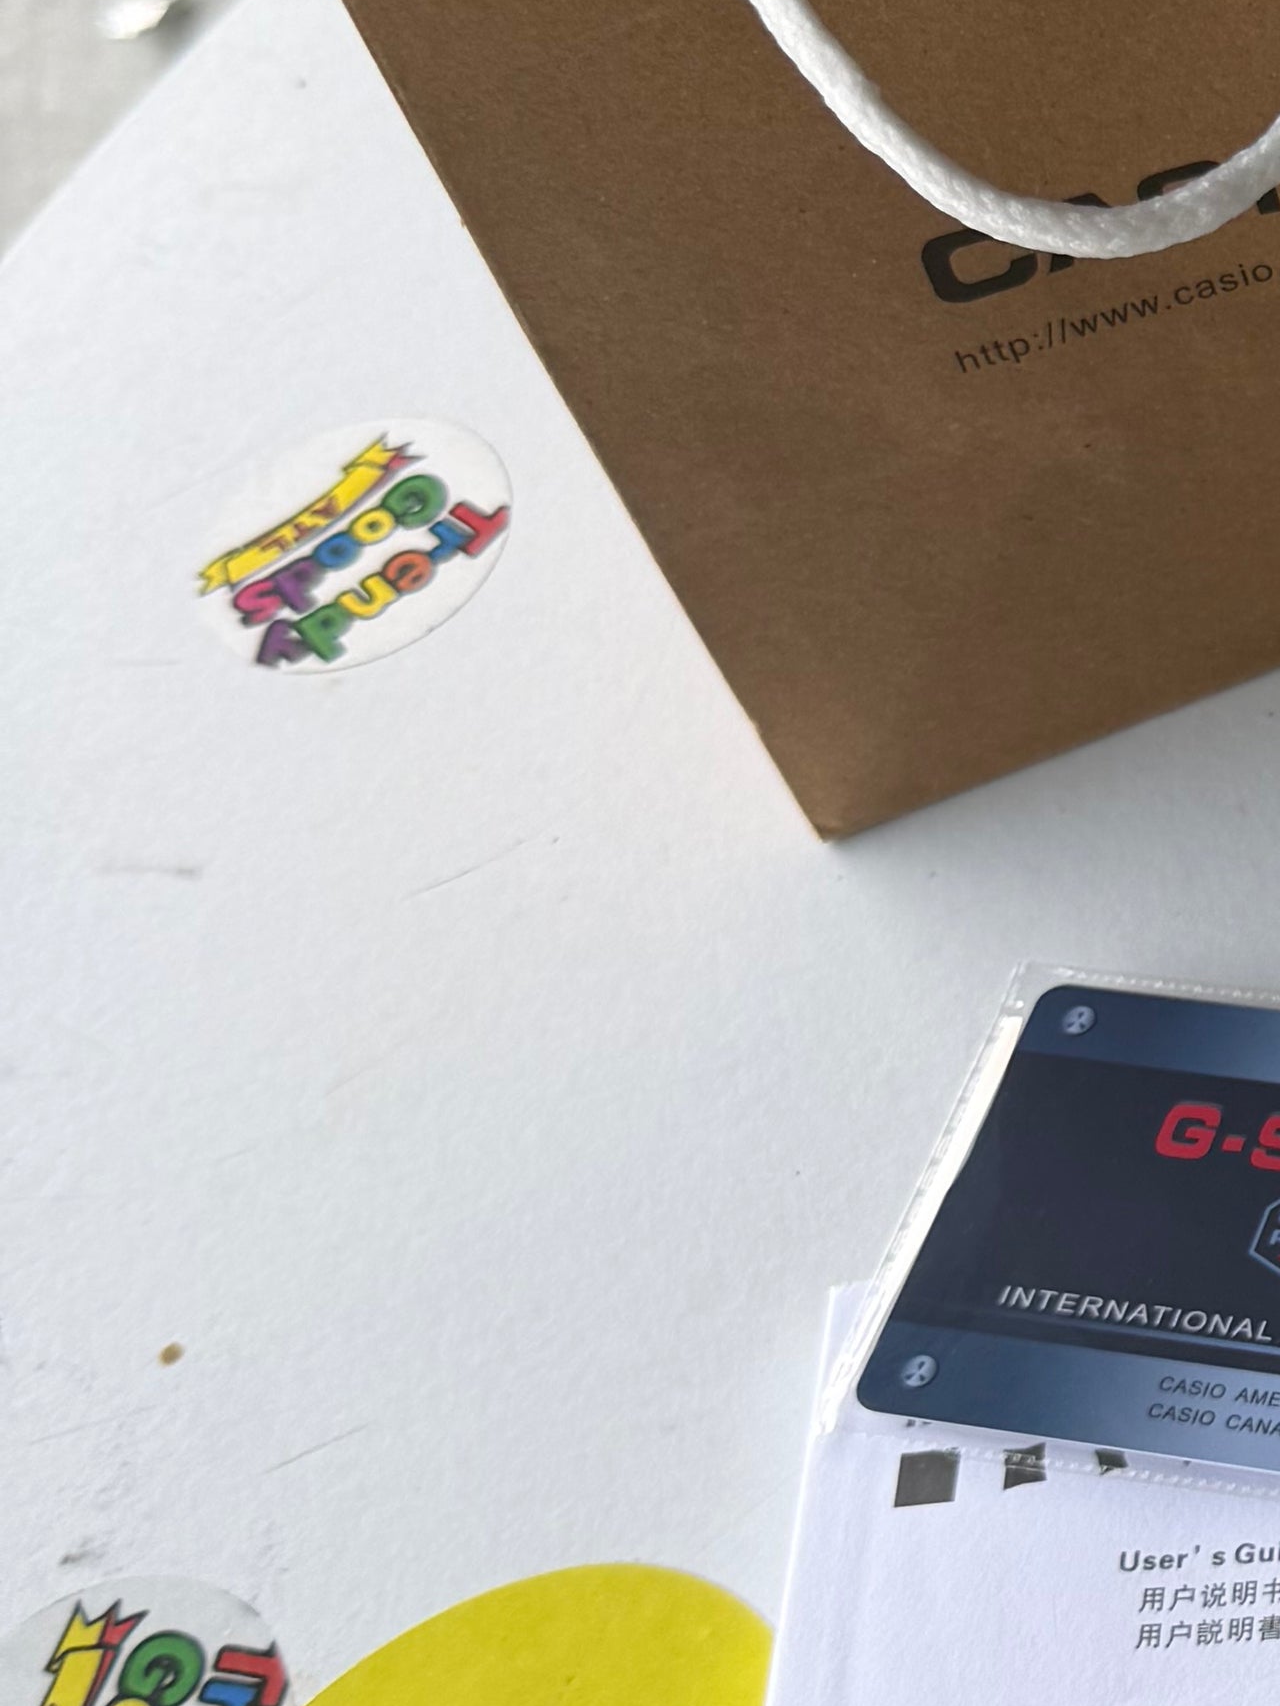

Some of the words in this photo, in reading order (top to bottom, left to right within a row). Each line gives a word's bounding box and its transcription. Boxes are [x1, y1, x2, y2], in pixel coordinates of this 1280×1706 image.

[232, 474, 449, 627] Goods
[254, 500, 510, 670] Trendy
[998, 1285, 1273, 1343] INTERNATIONAL
[1148, 1402, 1216, 1429] CASIO
[1158, 1375, 1229, 1402] CASIO
